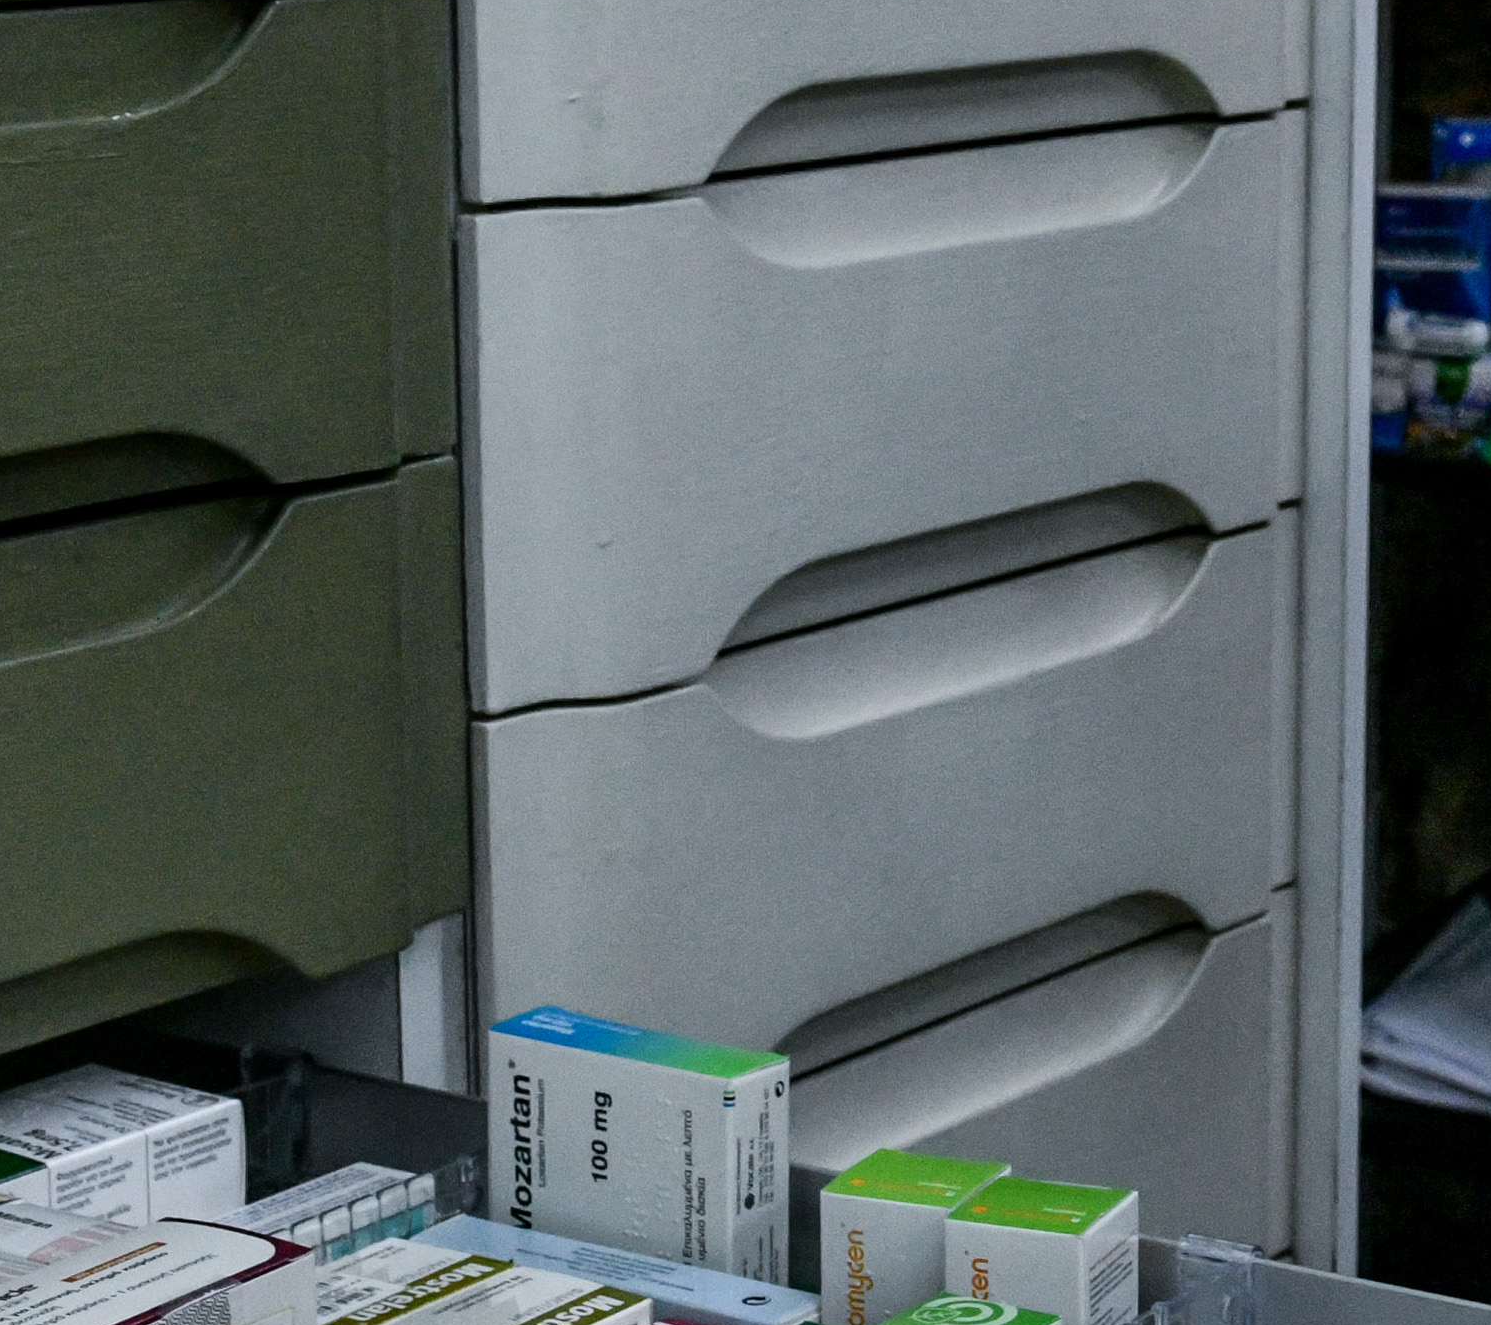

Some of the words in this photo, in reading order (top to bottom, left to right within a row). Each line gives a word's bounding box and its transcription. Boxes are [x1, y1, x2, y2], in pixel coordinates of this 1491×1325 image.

[594, 1091, 612, 1132] mg
[510, 1074, 532, 1230] Mozartan
[591, 1142, 609, 1183] 100
[348, 1261, 496, 1325] Mostrelan
